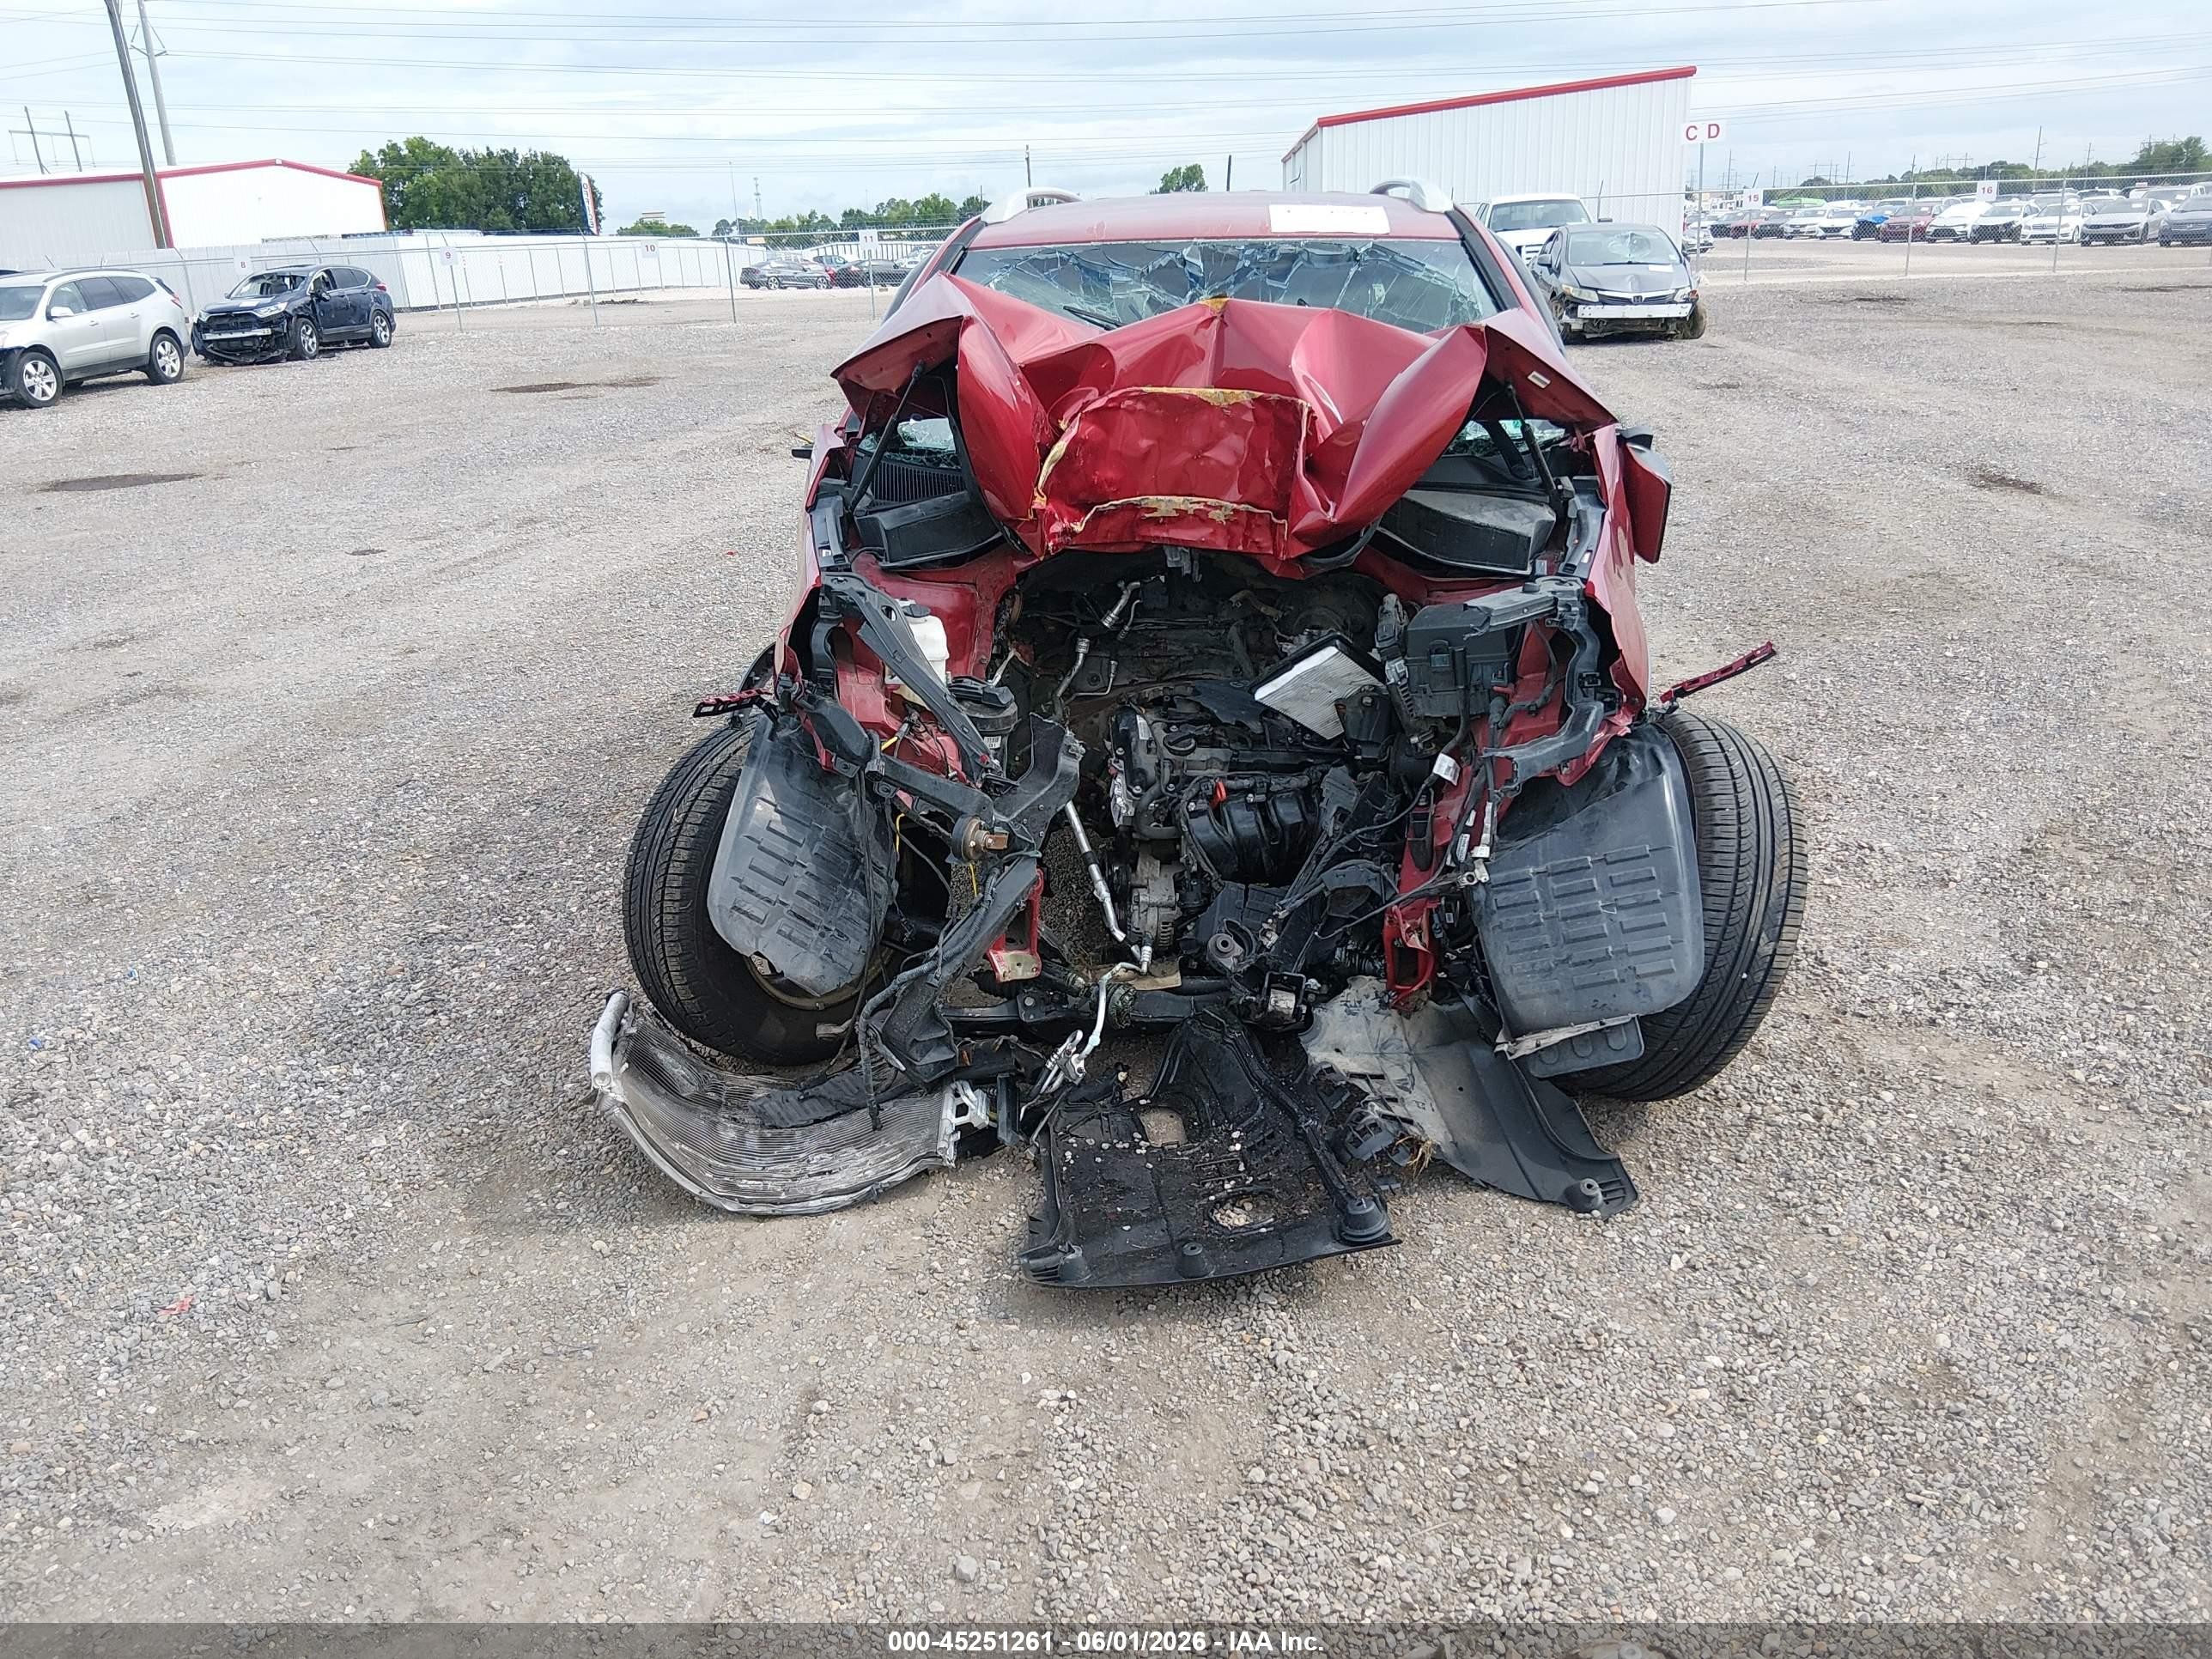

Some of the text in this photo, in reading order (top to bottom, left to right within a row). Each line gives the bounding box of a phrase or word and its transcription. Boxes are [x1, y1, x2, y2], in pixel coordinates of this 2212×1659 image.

[1686, 123, 1720, 141] C D
[645, 244, 656, 252] 10
